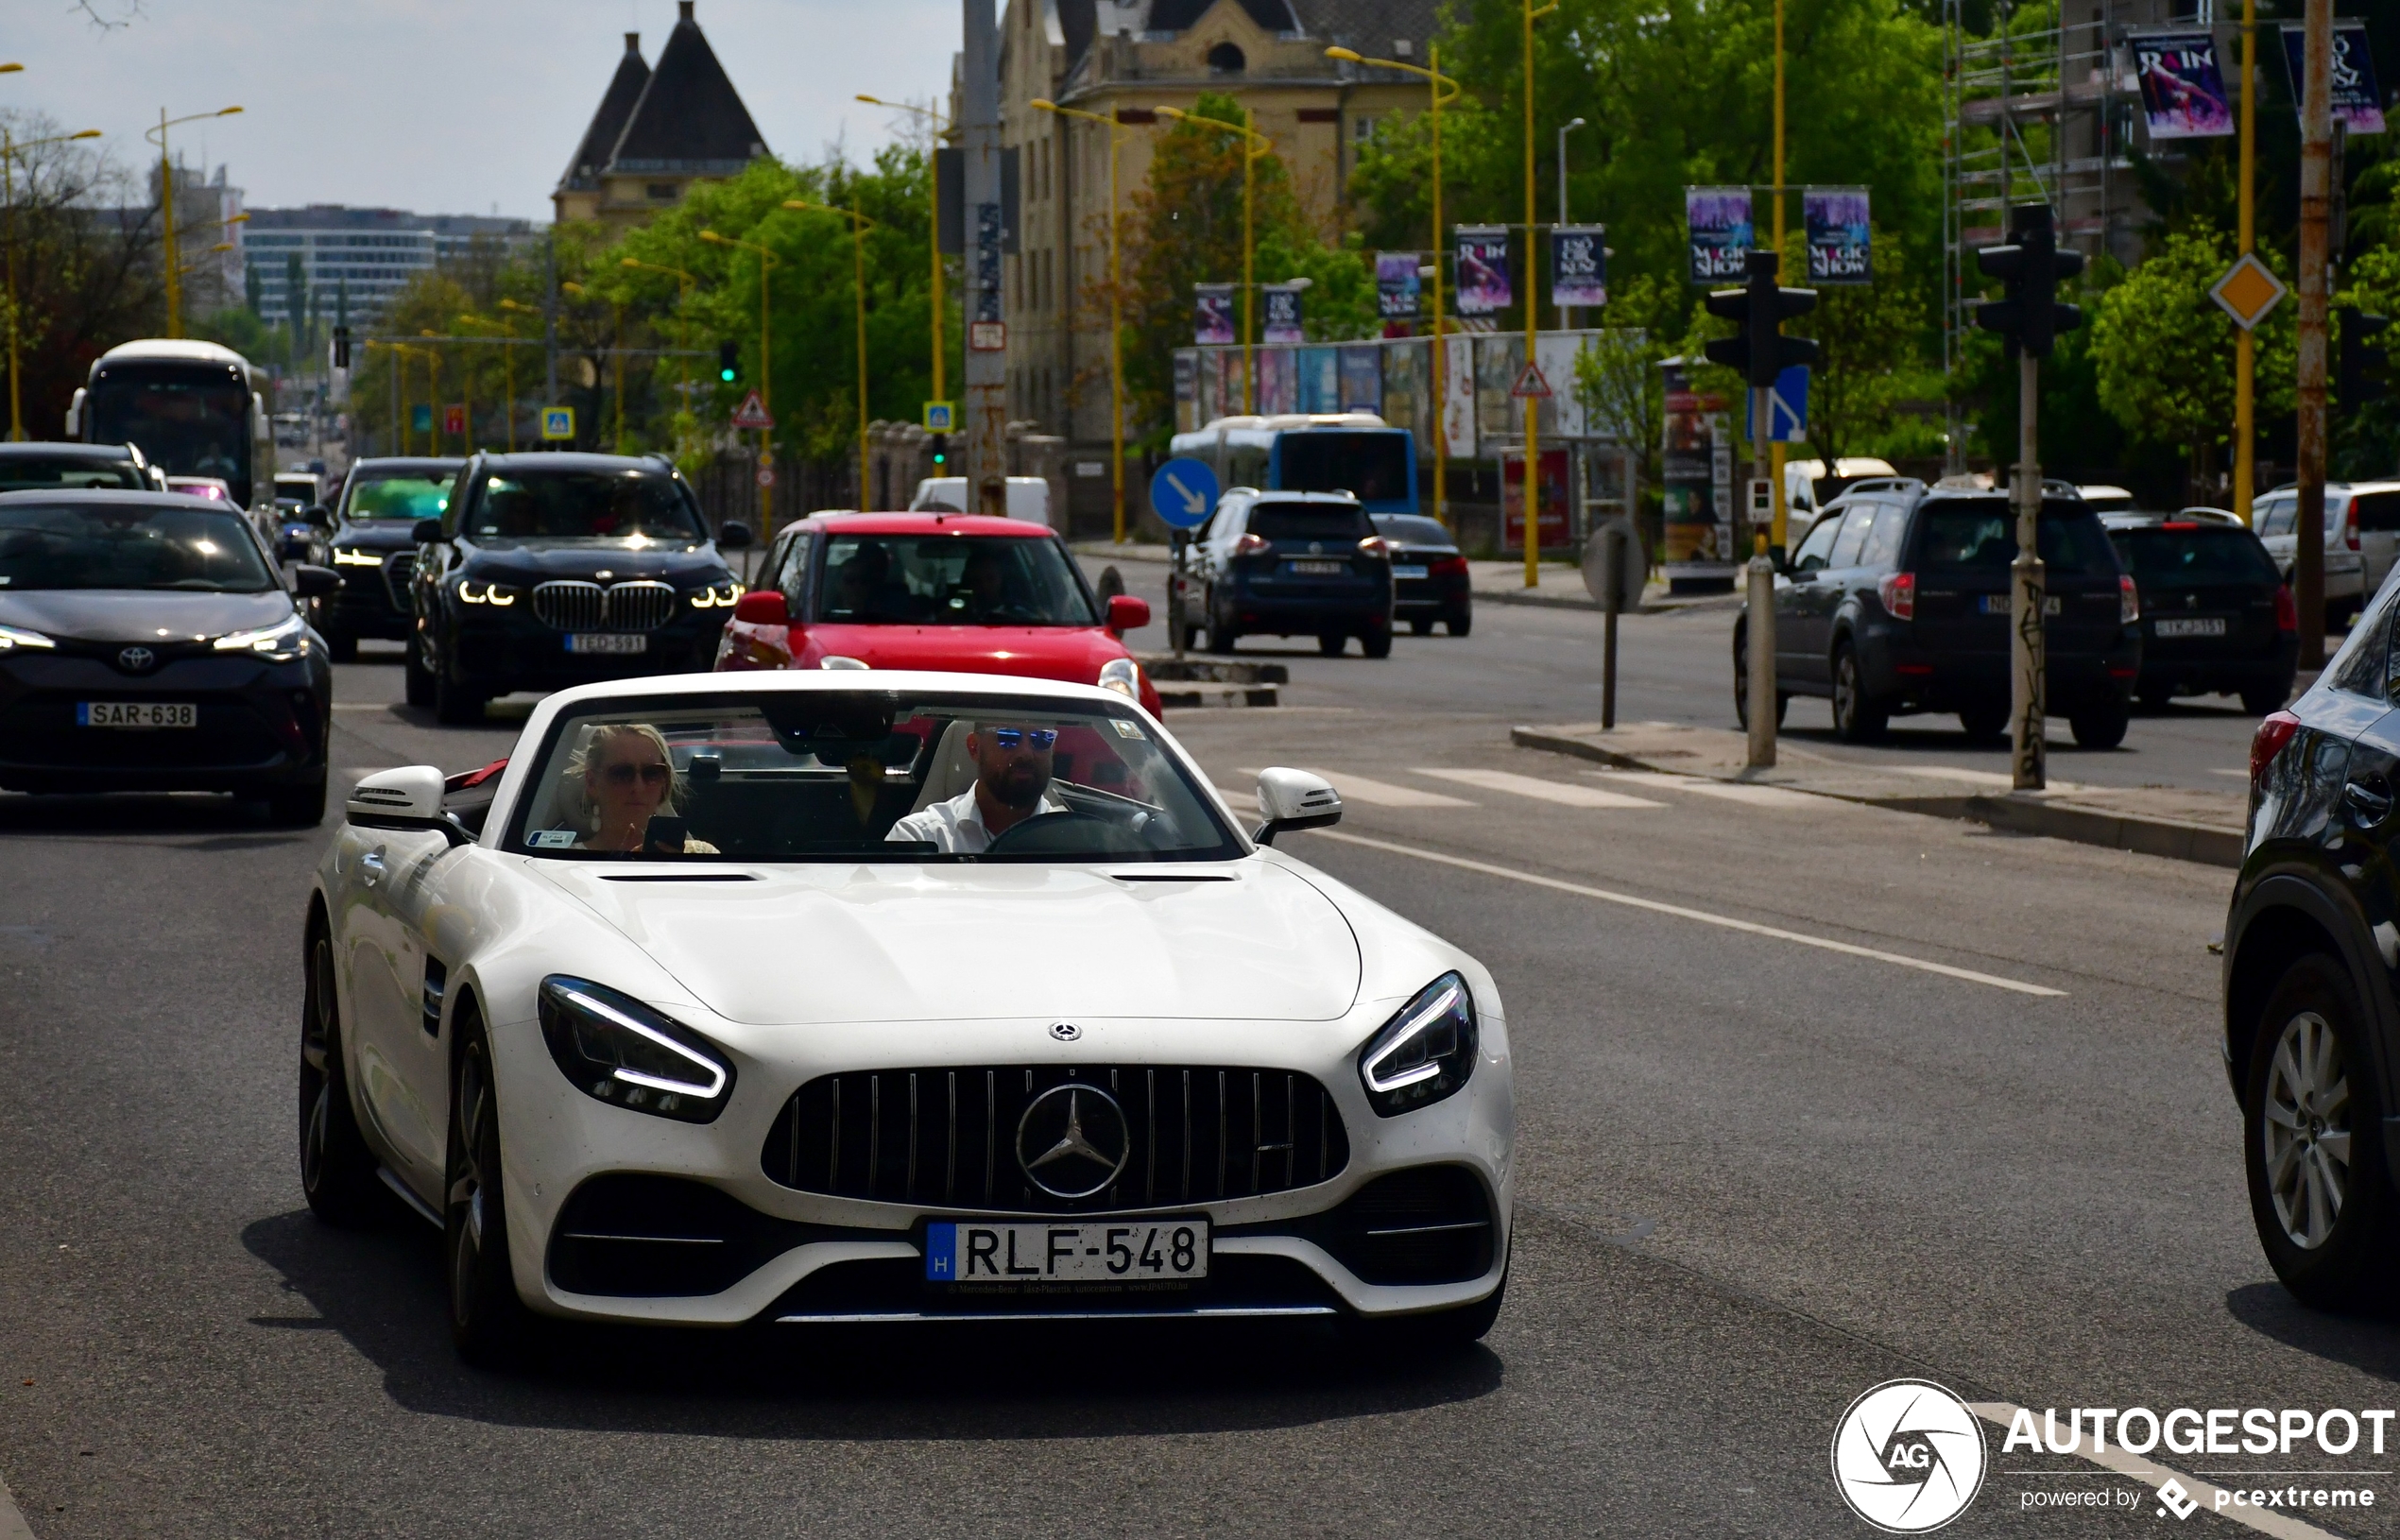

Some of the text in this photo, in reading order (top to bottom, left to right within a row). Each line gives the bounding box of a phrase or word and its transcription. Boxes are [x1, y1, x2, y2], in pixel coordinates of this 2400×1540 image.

[2138, 48, 2214, 76] RAIN
[1809, 246, 1867, 260] MAGIC
[1812, 257, 1865, 277] SHOW
[94, 705, 192, 725] SAR-638
[968, 1227, 1195, 1275] RLF-548
[934, 1257, 948, 1273] H
[958, 1284, 1018, 1294] Mercedes-Benz
